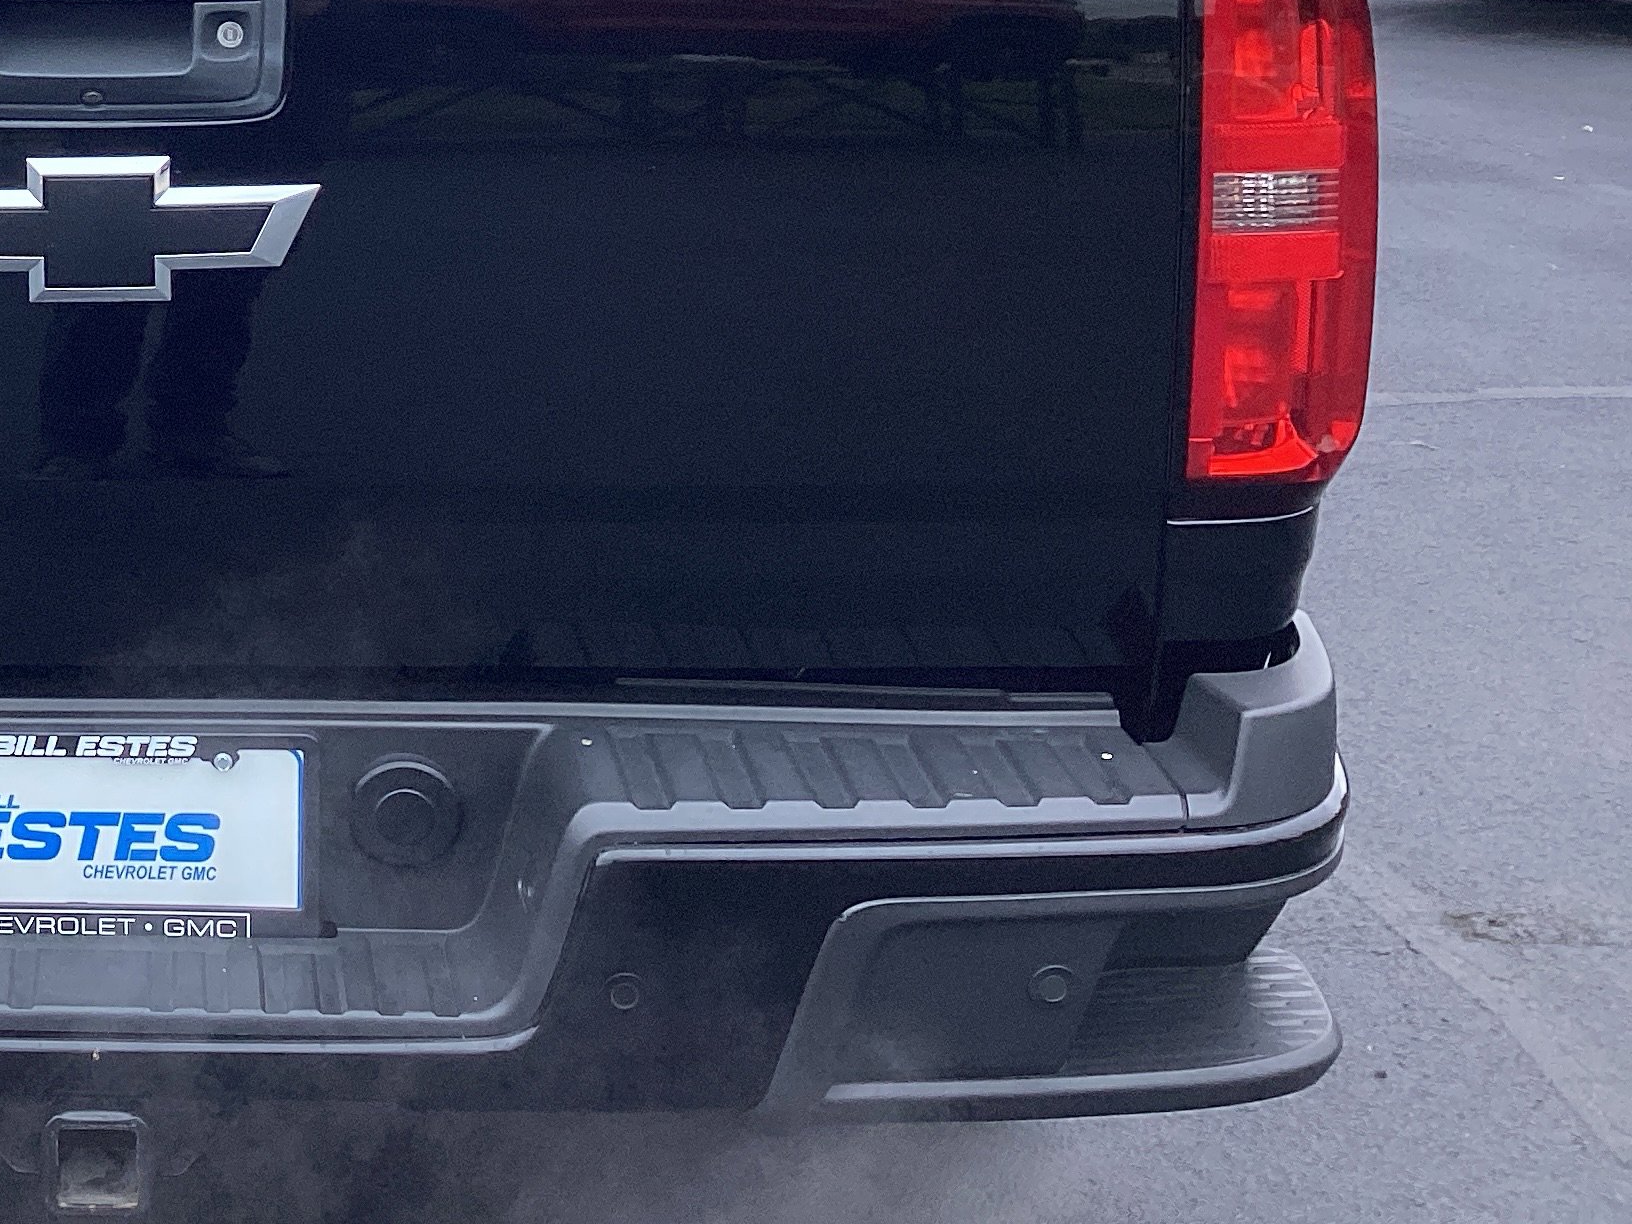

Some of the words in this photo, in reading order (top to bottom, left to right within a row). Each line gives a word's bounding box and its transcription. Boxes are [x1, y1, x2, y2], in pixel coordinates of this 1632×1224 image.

[76, 736, 198, 757] ESTES
[113, 757, 166, 765] CHEVROLET
[168, 757, 189, 765] GMC
[82, 864, 177, 881] CHEVROLET
[181, 866, 217, 881] GMC
[162, 918, 238, 938] GMC
